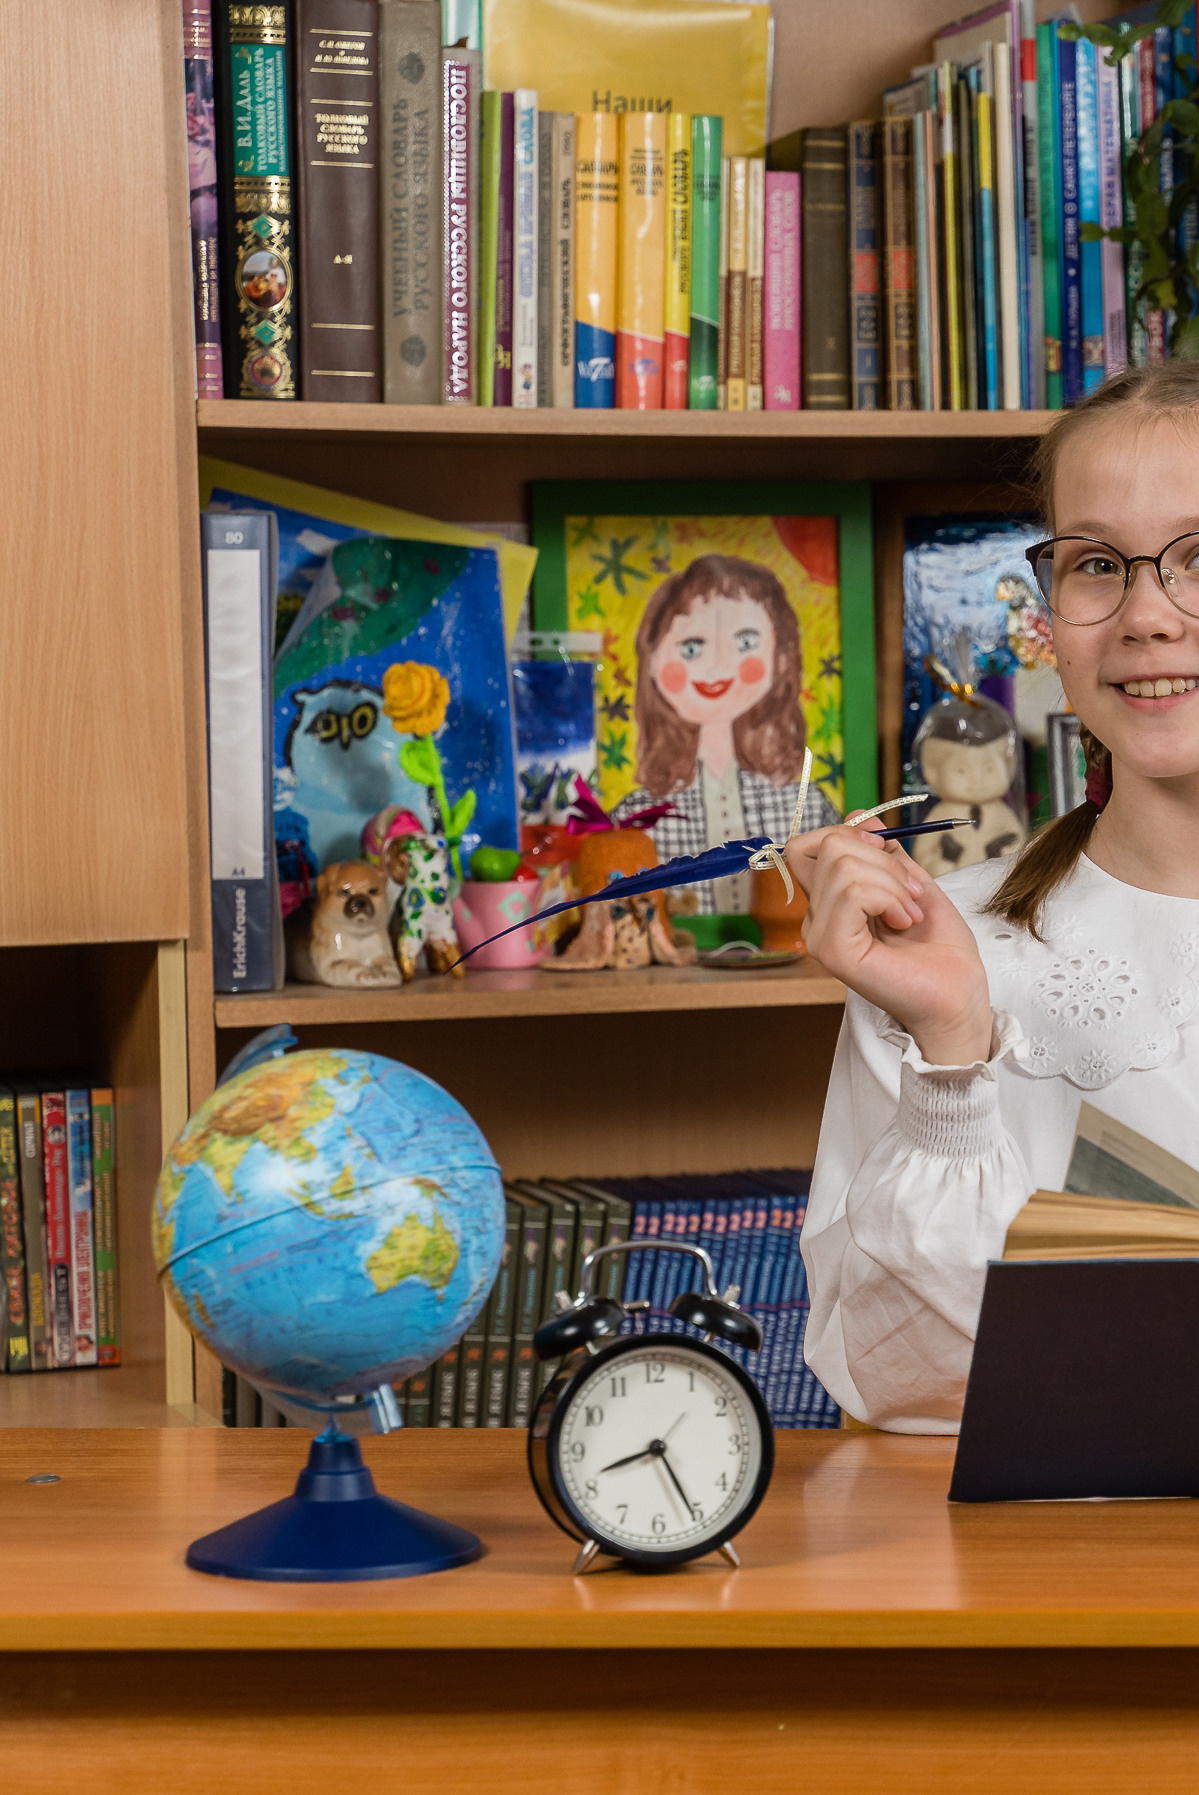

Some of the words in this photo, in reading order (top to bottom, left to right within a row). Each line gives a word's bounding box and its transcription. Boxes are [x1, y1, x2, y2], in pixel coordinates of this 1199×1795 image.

[253, 48, 266, 103] СЛОВАРЬ
[264, 57, 277, 100] ЯЗЫКА
[266, 100, 278, 165] РУССКОГО
[314, 113, 369, 126] ТОЛКОВЫЙ
[320, 124, 365, 135] СЛОВАРЬ
[448, 67, 468, 200] ПОСЛОВИЦЫ
[1102, 81, 1117, 177] МАТЕМАТИКА
[254, 104, 268, 172] ТОЛКОВЫЙ
[316, 132, 368, 146] РУССКОГО
[325, 144, 360, 154] ЯЗЫКА
[391, 98, 409, 200] СЛОВАРЬ
[412, 108, 430, 184] ЯЗЫКА
[518, 106, 534, 166] СЛОВА
[560, 177, 571, 230] СЛОВАРЬ
[389, 206, 412, 318] УЧЕБНЫЙ
[412, 193, 432, 312] РУССКОГО
[449, 202, 468, 308] РУССКОГО
[559, 238, 571, 367] ОРФОГРАФИЧЕСКИЙ
[449, 311, 469, 394] НАРОДА
[232, 887, 247, 979] ErichKrause
[610, 1378, 627, 1398] 11
[646, 1364, 666, 1384] 12
[687, 1372, 696, 1392] 1
[584, 1405, 604, 1426] 10
[715, 1398, 728, 1417] 2
[572, 1442, 585, 1463] 9
[728, 1435, 741, 1456] 3
[585, 1479, 598, 1500] 8
[716, 1472, 728, 1492] 4
[616, 1504, 629, 1524] 7
[652, 1514, 666, 1535] 6
[692, 1503, 704, 1522] 5
